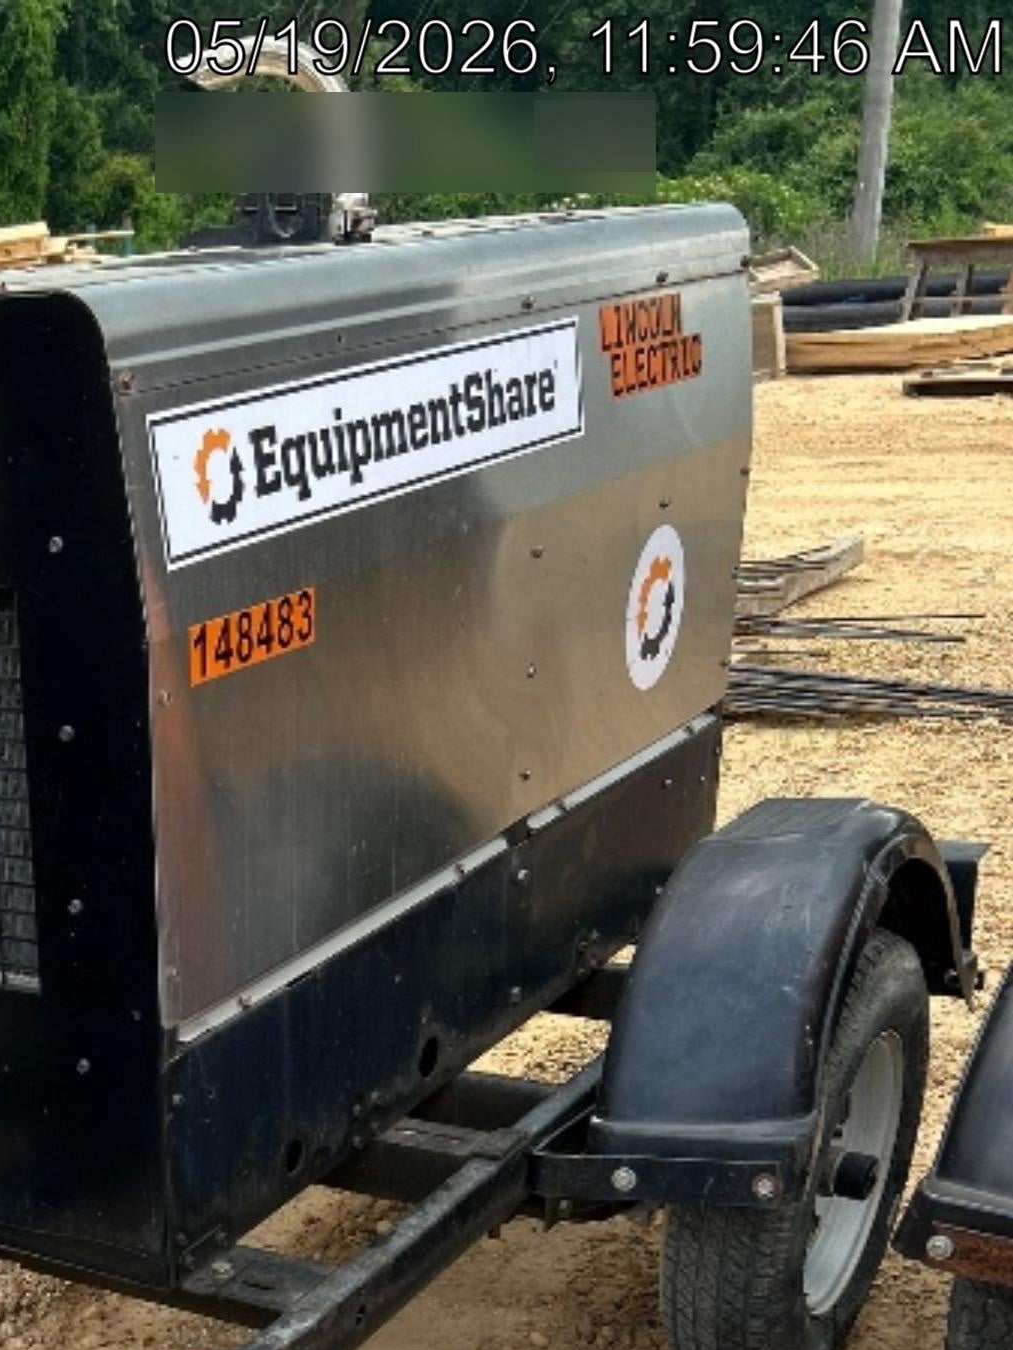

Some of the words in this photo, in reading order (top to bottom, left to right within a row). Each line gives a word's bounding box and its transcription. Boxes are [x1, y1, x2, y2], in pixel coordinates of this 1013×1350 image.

[599, 292, 681, 351] LINCOLN
[611, 332, 702, 396] ELECTRIC
[248, 368, 556, 501] EquipmentShare
[193, 590, 313, 677] 148483
